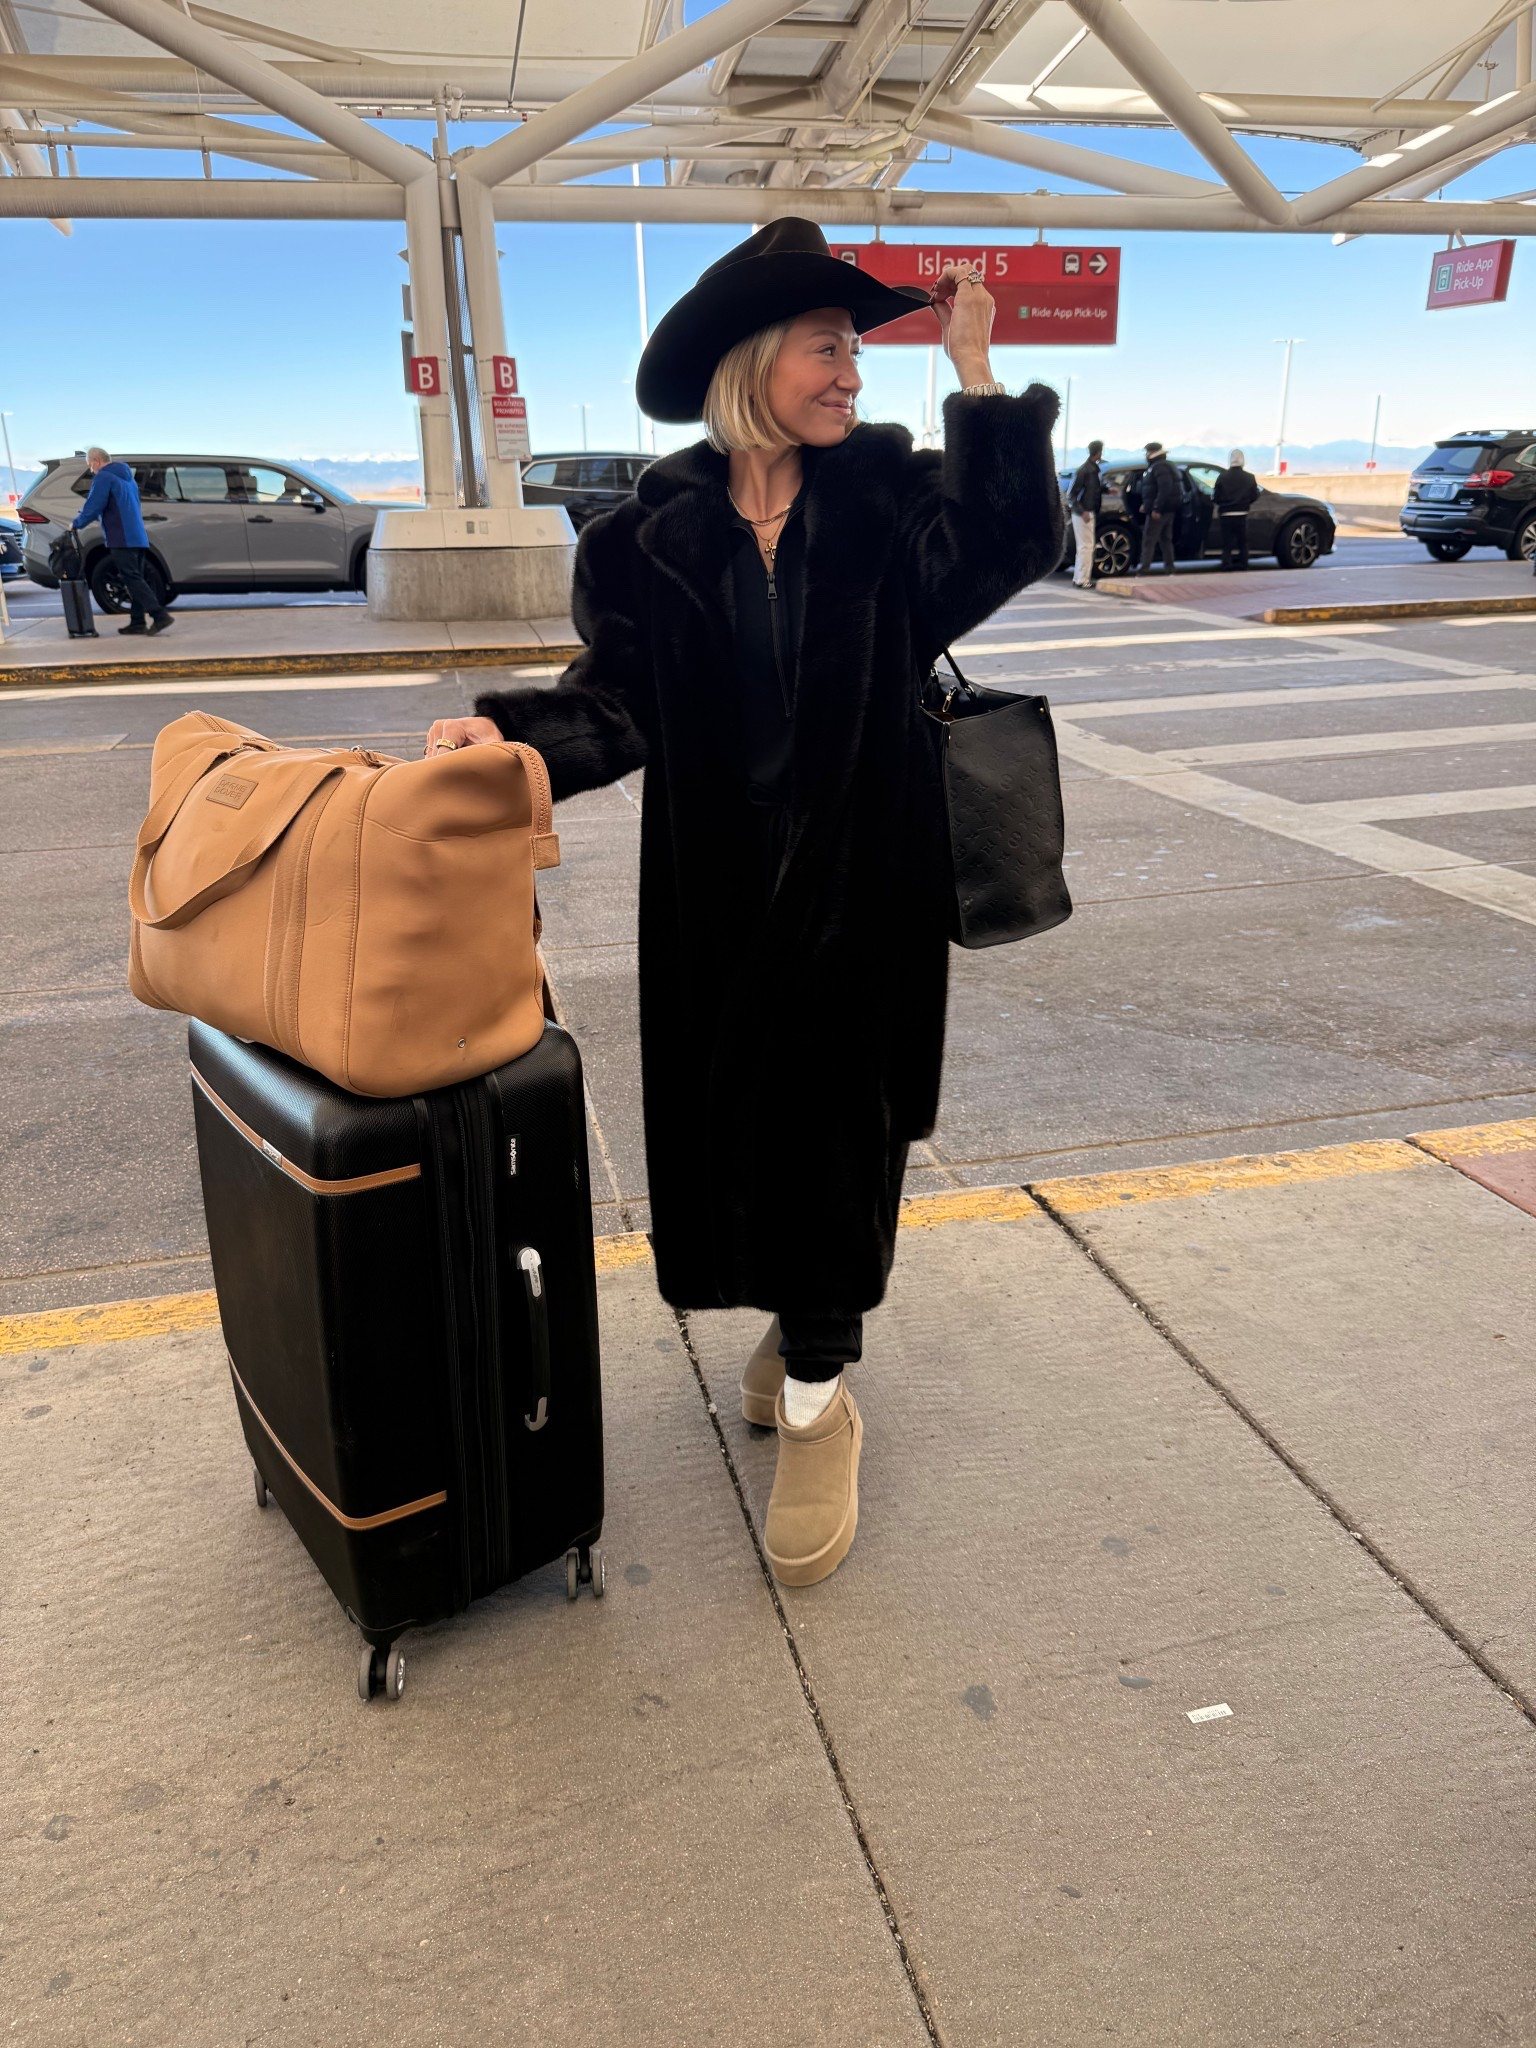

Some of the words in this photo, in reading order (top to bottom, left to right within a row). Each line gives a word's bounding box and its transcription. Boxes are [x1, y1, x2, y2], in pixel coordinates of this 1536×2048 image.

[995, 253, 1008, 276] 5
[1455, 260, 1474, 273] Ride
[1475, 258, 1494, 272] App
[1453, 276, 1484, 291] Pick-Up
[1031, 307, 1051, 317] Ride
[1053, 307, 1073, 320] App
[1074, 307, 1108, 320] Pick-Up
[418, 363, 434, 389] B
[499, 362, 514, 388] B
